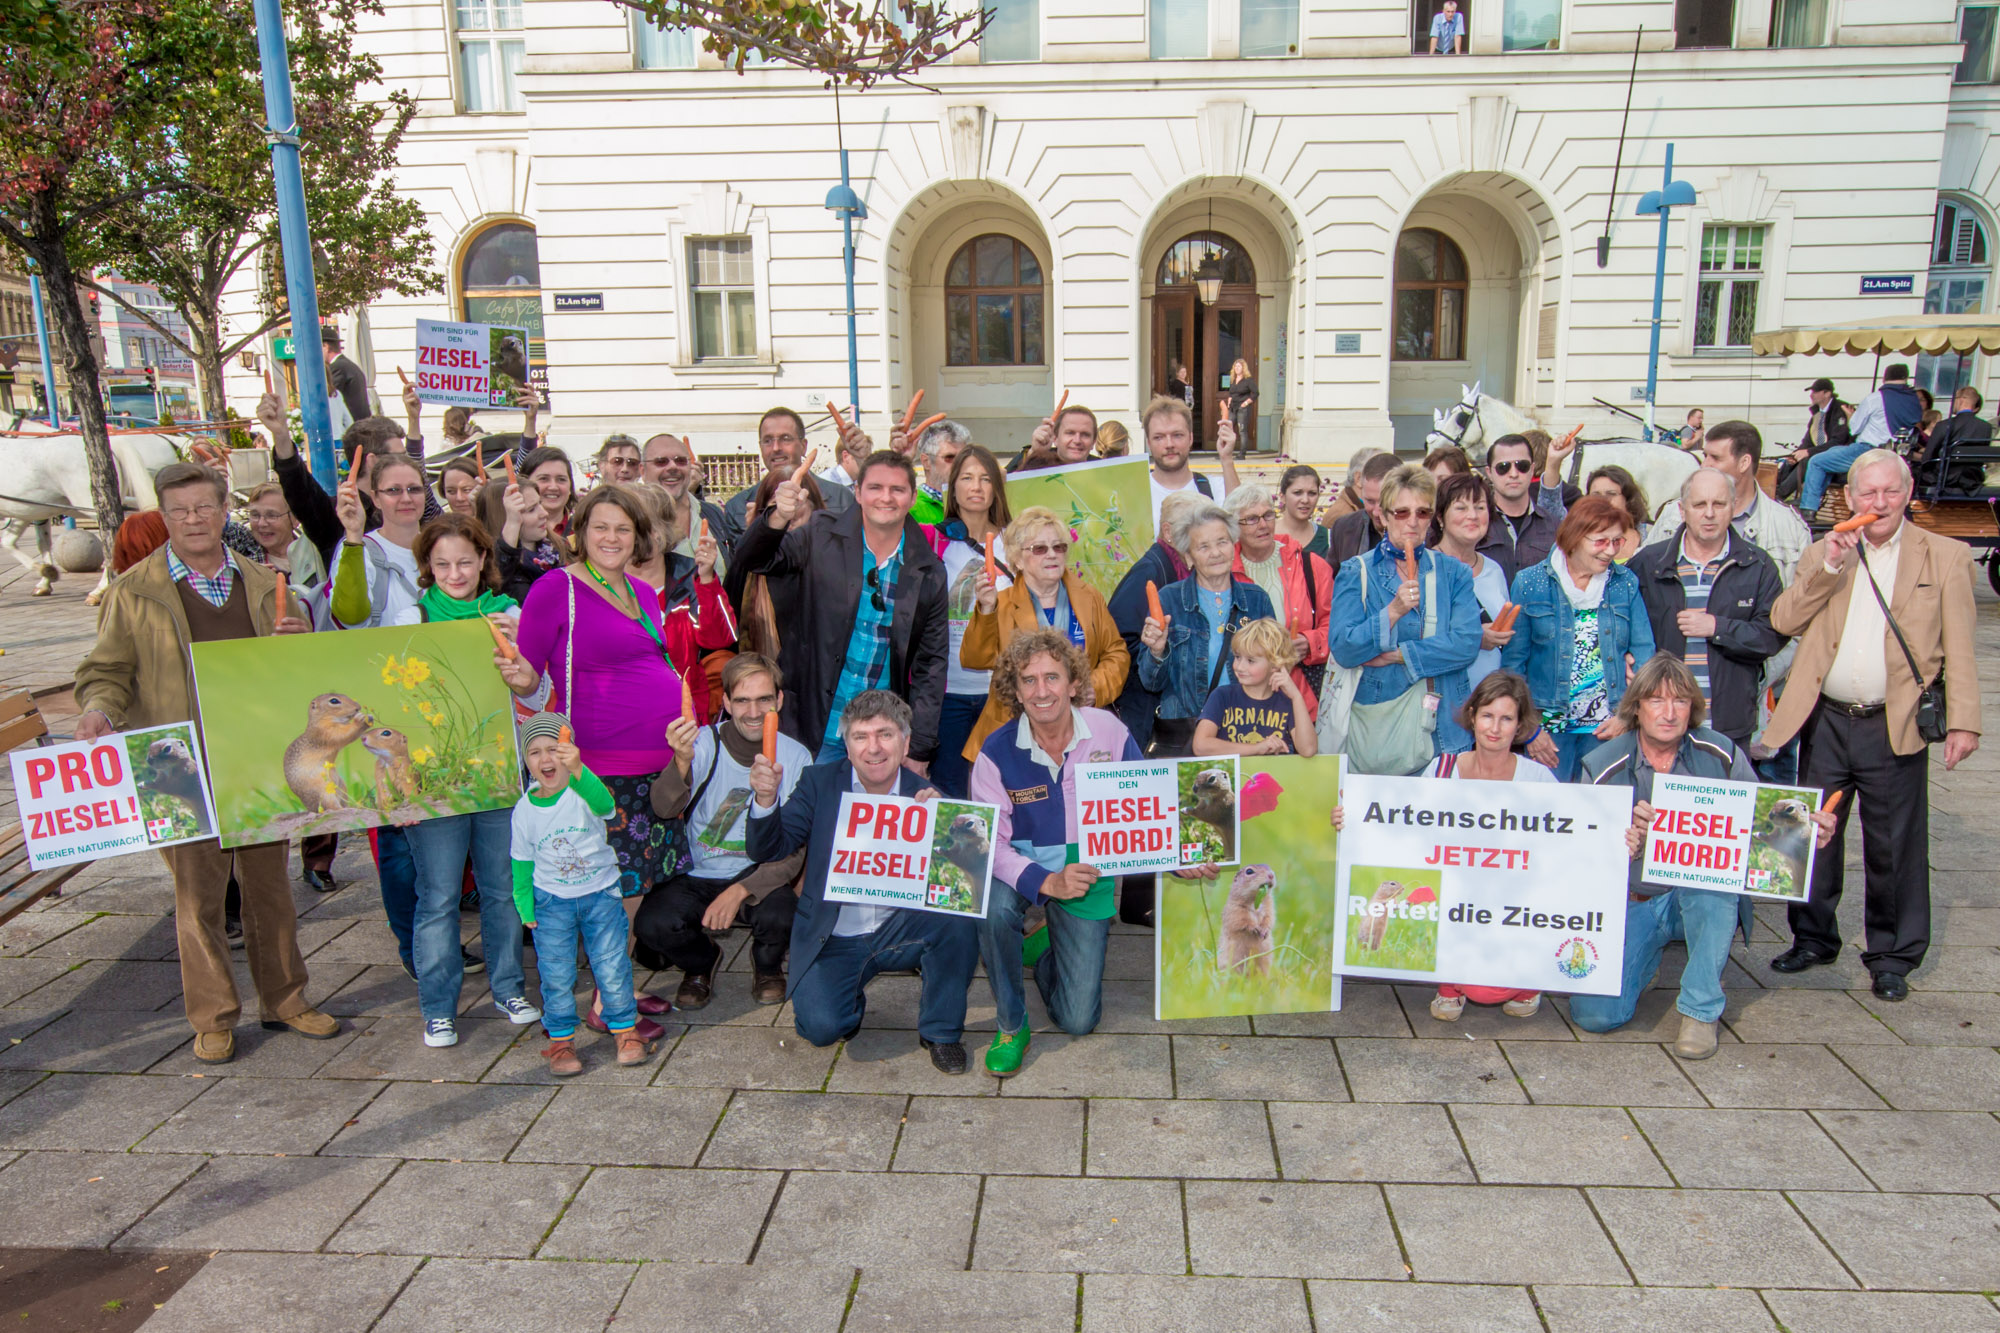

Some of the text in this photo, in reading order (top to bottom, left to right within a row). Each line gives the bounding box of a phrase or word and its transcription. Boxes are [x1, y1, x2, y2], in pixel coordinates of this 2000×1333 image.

[1890, 280, 1911, 289] Spitz
[527, 300, 542, 315] Ba
[581, 297, 600, 306] Spitz
[447, 327, 464, 335] SIND
[464, 328, 479, 336] FÜR
[520, 320, 543, 329] IMBI
[284, 342, 296, 354] do
[418, 346, 489, 369] ZIESEL-
[417, 371, 489, 393] SCHUTZ!
[418, 393, 488, 404] WIENER NATURWACHT
[25, 745, 123, 800] PRO
[1087, 768, 1169, 780] VERHINDERN WIR
[1016, 788, 1046, 797] MOUNTAIN
[1119, 781, 1138, 789] DEN
[1665, 783, 1748, 798] VERHINDERN WIR
[1694, 796, 1714, 805] DEN
[27, 796, 139, 840] ZIESEL!
[1081, 796, 1176, 826] ZIESEL-
[1363, 801, 1574, 834] Artenschutz
[846, 802, 928, 843] PRO
[1652, 808, 1748, 840] ZIESEL-
[35, 834, 145, 862] WIENER NATURWACHT
[1087, 827, 1173, 857] MORD!
[833, 850, 927, 881] ZIESEL!
[1120, 856, 1178, 869] NATURWACHT
[1425, 845, 1529, 870] JETZT!
[1653, 839, 1741, 872] MORD!
[1648, 868, 1743, 887] WIENER NATURWACHT
[830, 886, 924, 901] WIENER NATURWACHT
[1349, 895, 1604, 932] Rettet die Ziesel!
[1555, 938, 1571, 957] Rettet
[1585, 940, 1600, 960] Ziesel
